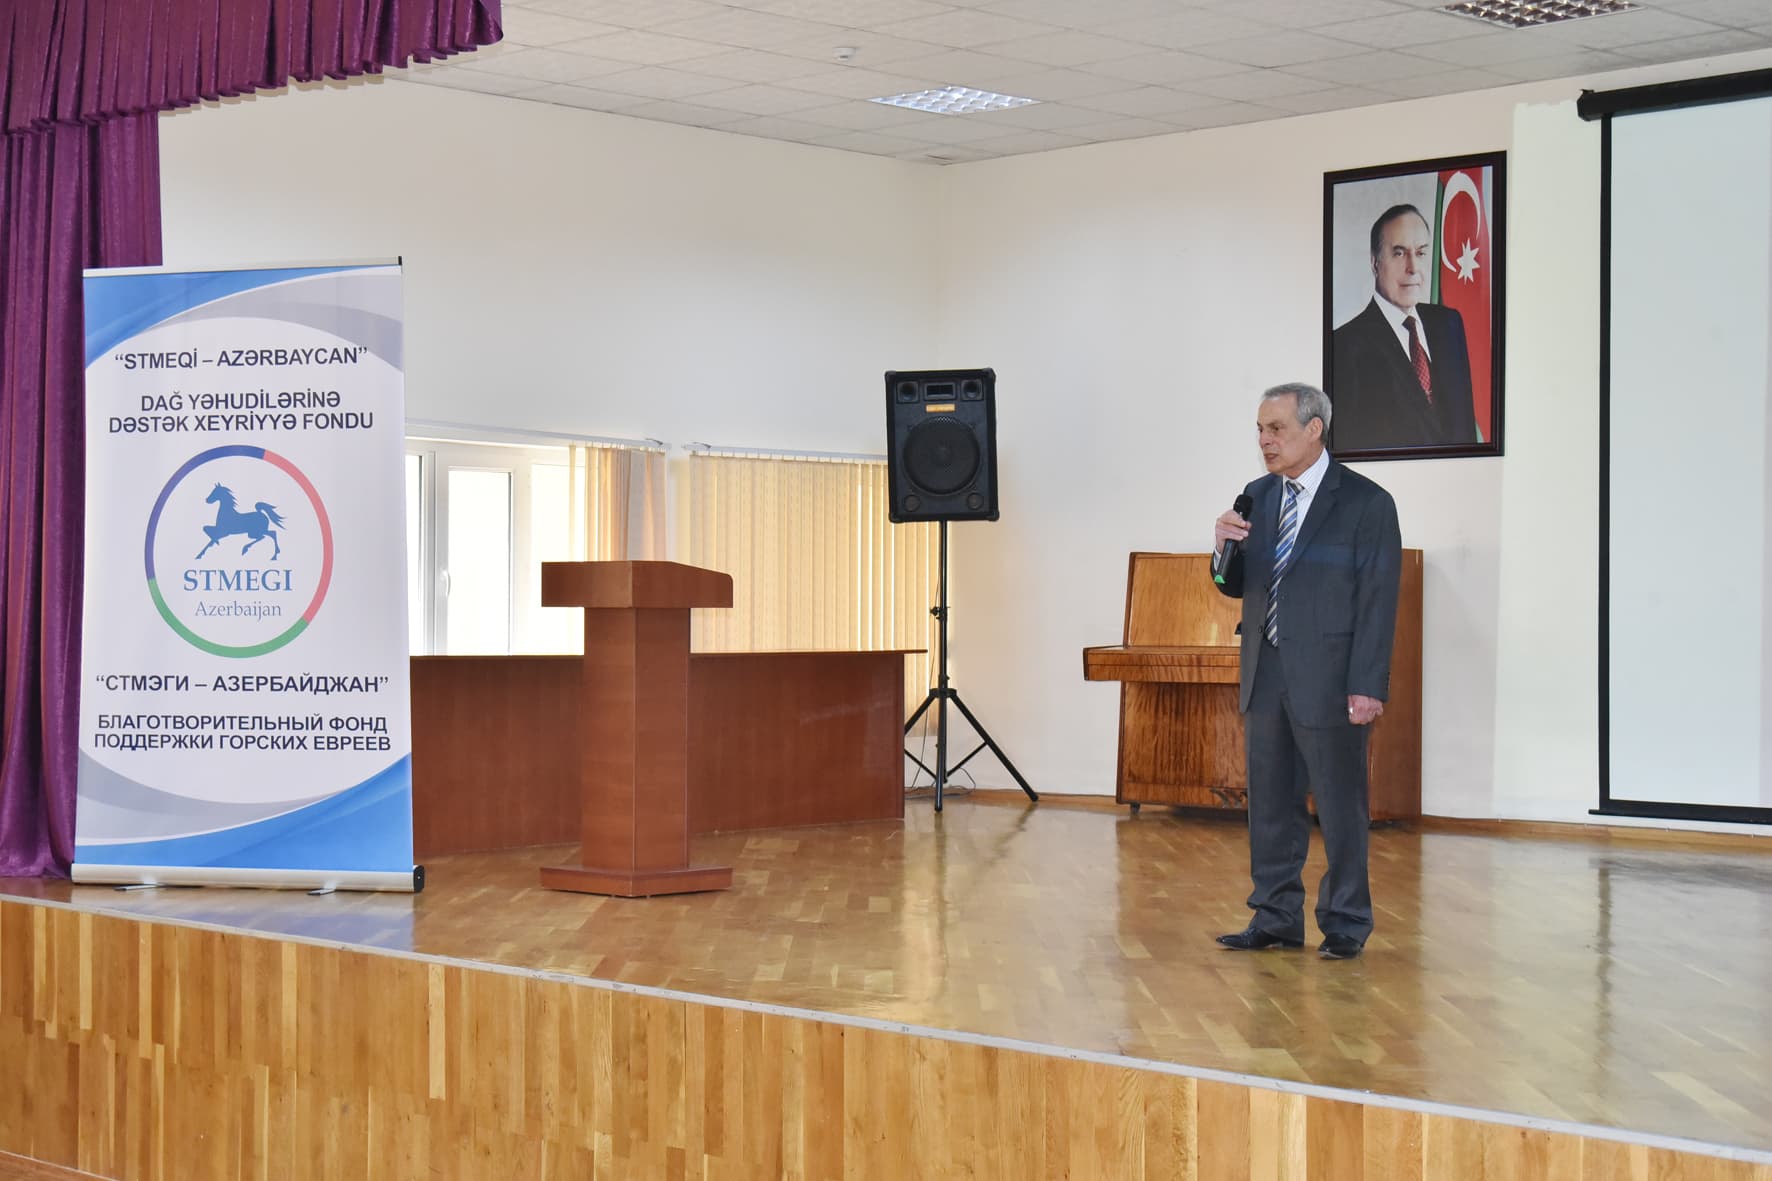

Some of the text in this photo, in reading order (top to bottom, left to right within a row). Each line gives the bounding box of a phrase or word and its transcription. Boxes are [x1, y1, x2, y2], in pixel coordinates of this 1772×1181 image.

[115, 348, 198, 369] “STMEQİ
[217, 347, 368, 367] AZƏRBAYCAN”
[141, 388, 341, 412] DAĞ YƏHUDİLƏRİNƏ
[109, 411, 374, 433] DƏSTƏK XEYRİYYƏ FONDU
[183, 569, 292, 592] STMEGI
[194, 601, 282, 622] Azerbaijan
[96, 675, 189, 692] “СТМЭГИ
[212, 673, 389, 695] АЗЕРБАЙДЖАН”
[98, 713, 388, 734] БЛАГОТВОРИТЕЛЬНЫЙ ФОНД
[94, 734, 391, 751] ПОДДЕРЖКИ ГОРСКИХ ЕВРЕЕВ
